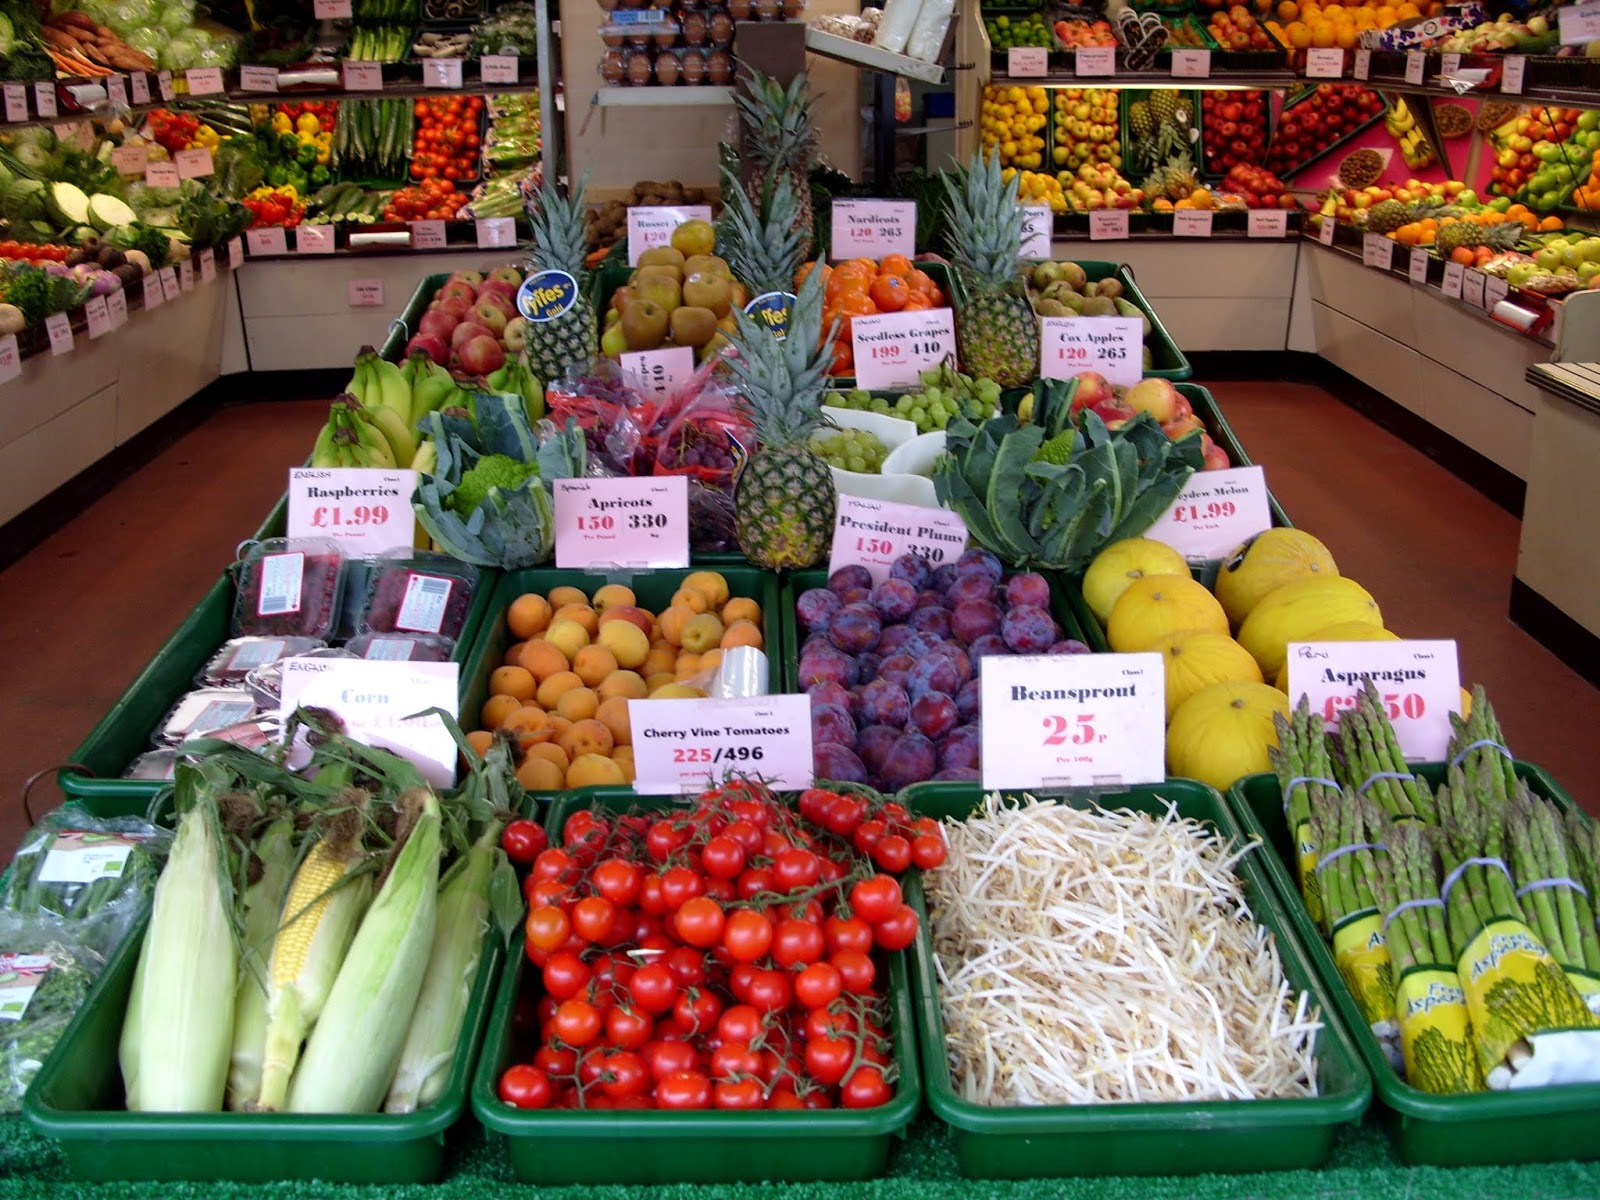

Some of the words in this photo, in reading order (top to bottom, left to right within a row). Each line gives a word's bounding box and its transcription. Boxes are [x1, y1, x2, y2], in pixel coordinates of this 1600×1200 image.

[850, 227, 872, 237] 120
[1021, 223, 1034, 233] 65
[856, 331, 906, 343] Seedless
[909, 327, 950, 338] Grapes
[1060, 332, 1081, 343] Cox
[1086, 333, 1124, 345] Apples
[871, 345, 900, 359] 199
[911, 341, 941, 355] 440
[1058, 348, 1087, 359] 120
[1097, 347, 1127, 359] 265
[307, 485, 399, 500] Raspberries
[1214, 487, 1249, 497] Melon
[588, 497, 653, 511] Apricots
[1173, 501, 1236, 523] £1.99
[310, 505, 389, 528] £1.99
[577, 516, 615, 530] 150
[628, 513, 668, 529] 330
[840, 515, 912, 536] President
[917, 526, 963, 543] Plums
[856, 537, 893, 555] 150
[907, 543, 944, 562] 330
[1321, 668, 1426, 686] Asparagus
[341, 689, 390, 704] Corn
[1010, 684, 1137, 703] Beansprout
[643, 729, 687, 740] Cherry
[690, 728, 721, 737] Vine
[724, 726, 790, 736] Tomatoes
[673, 746, 764, 763] 225/496
